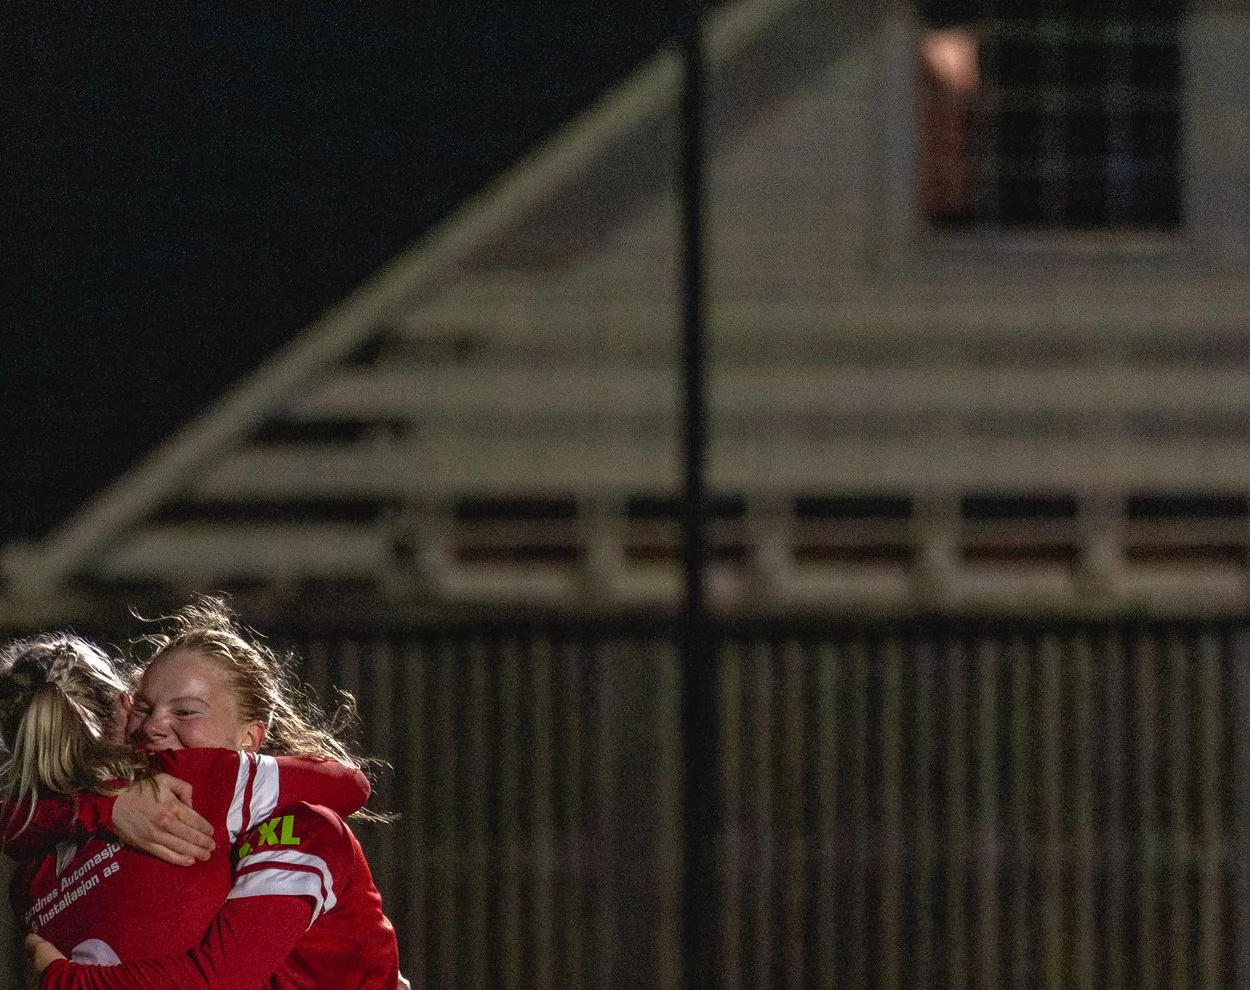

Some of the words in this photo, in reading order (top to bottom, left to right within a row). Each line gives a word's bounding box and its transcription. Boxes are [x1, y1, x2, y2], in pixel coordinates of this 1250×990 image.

[38, 874, 100, 927] Installasjon
[102, 861, 120, 878] as
[60, 842, 125, 892] Automasjo
